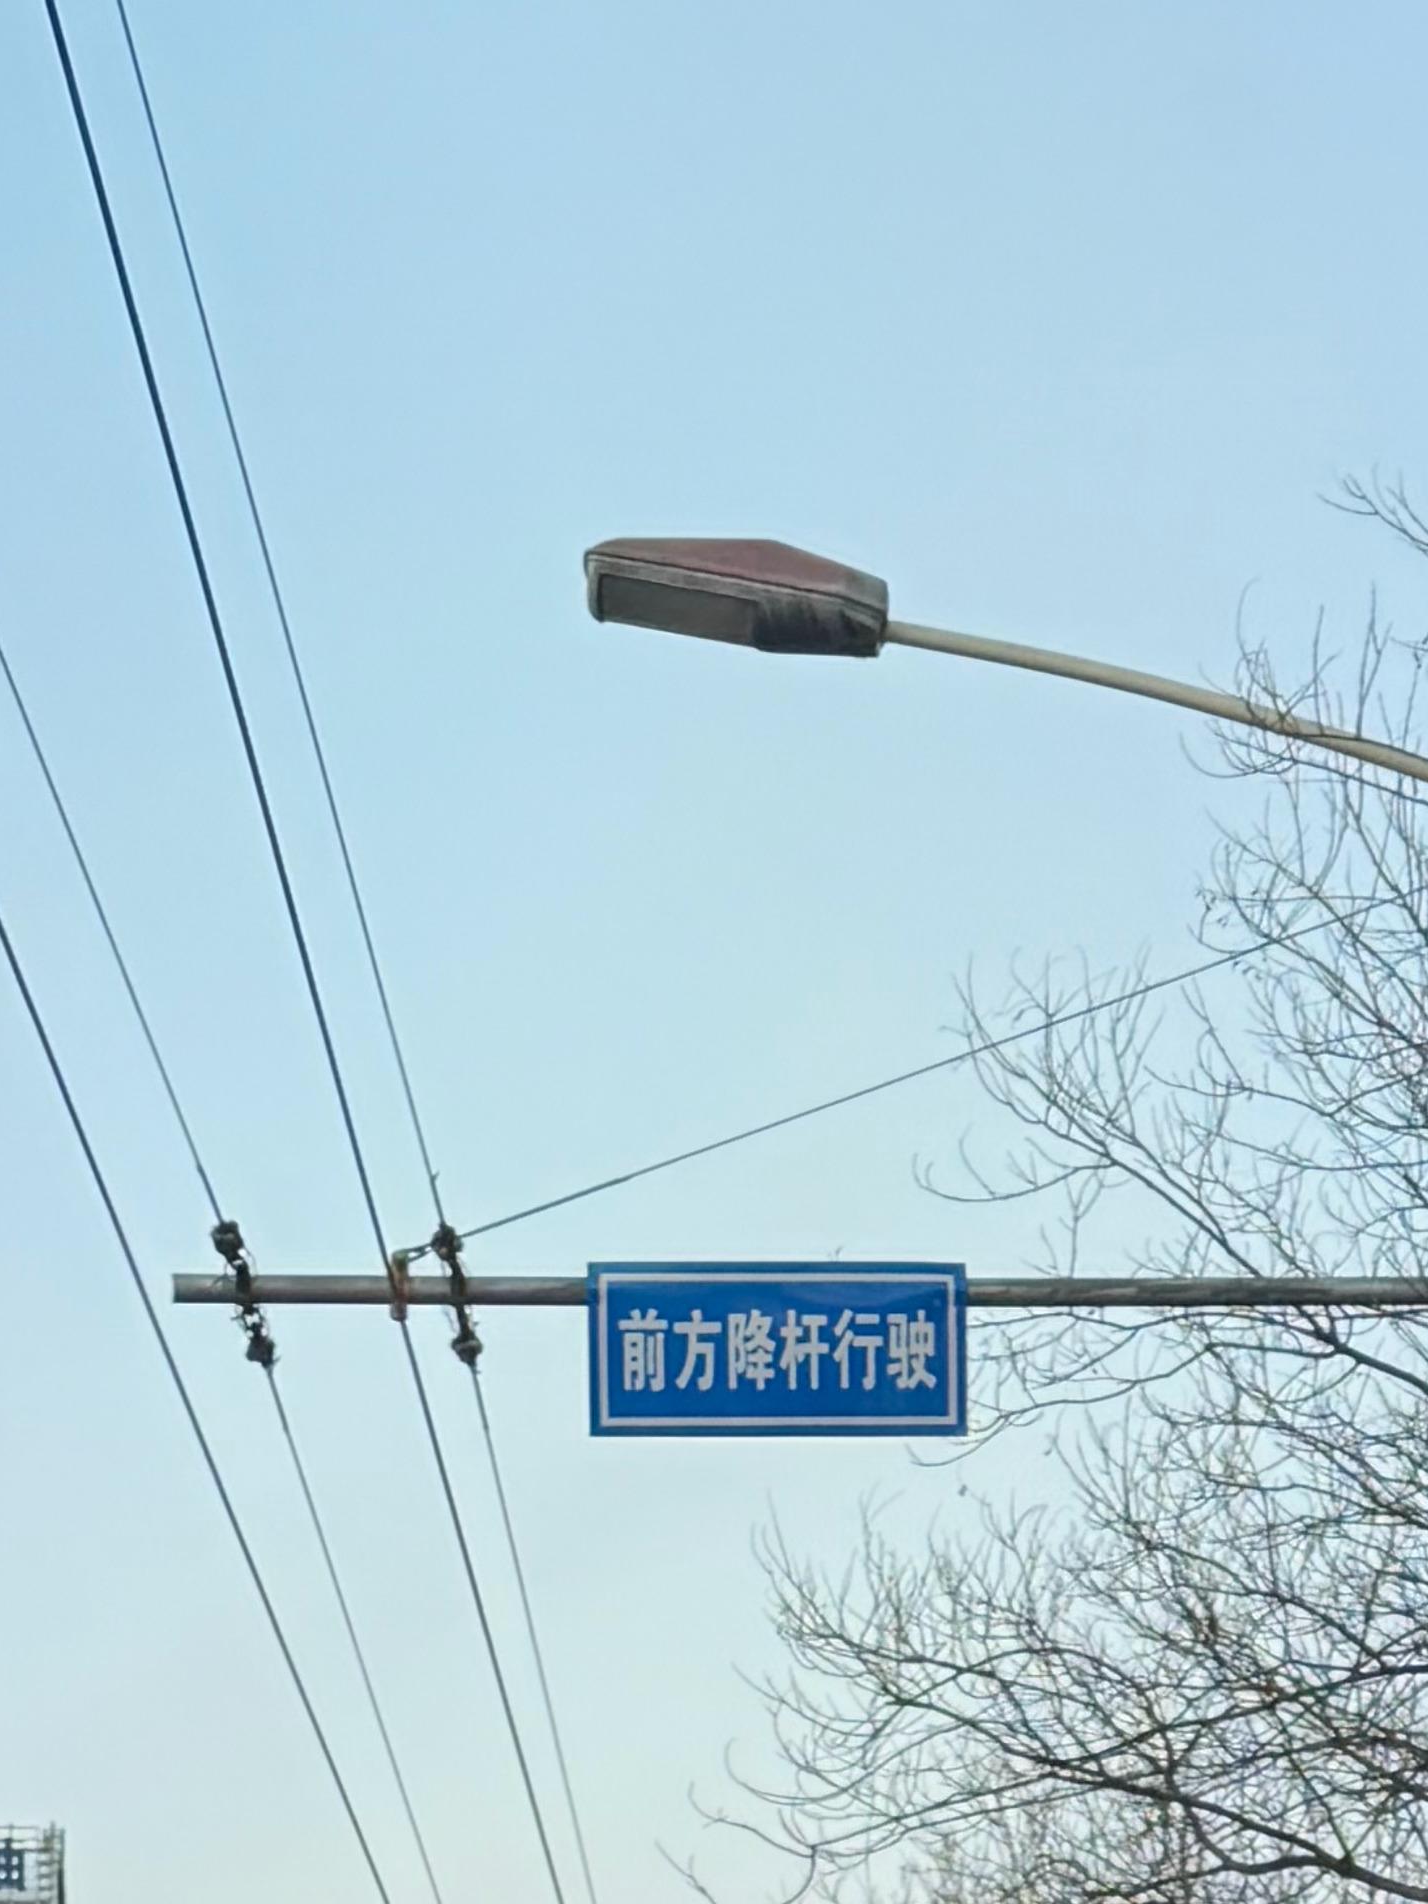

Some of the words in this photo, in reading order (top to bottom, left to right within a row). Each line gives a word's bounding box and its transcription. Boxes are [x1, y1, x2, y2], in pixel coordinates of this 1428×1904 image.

[617, 1308, 937, 1392] 前方降杆行驶
